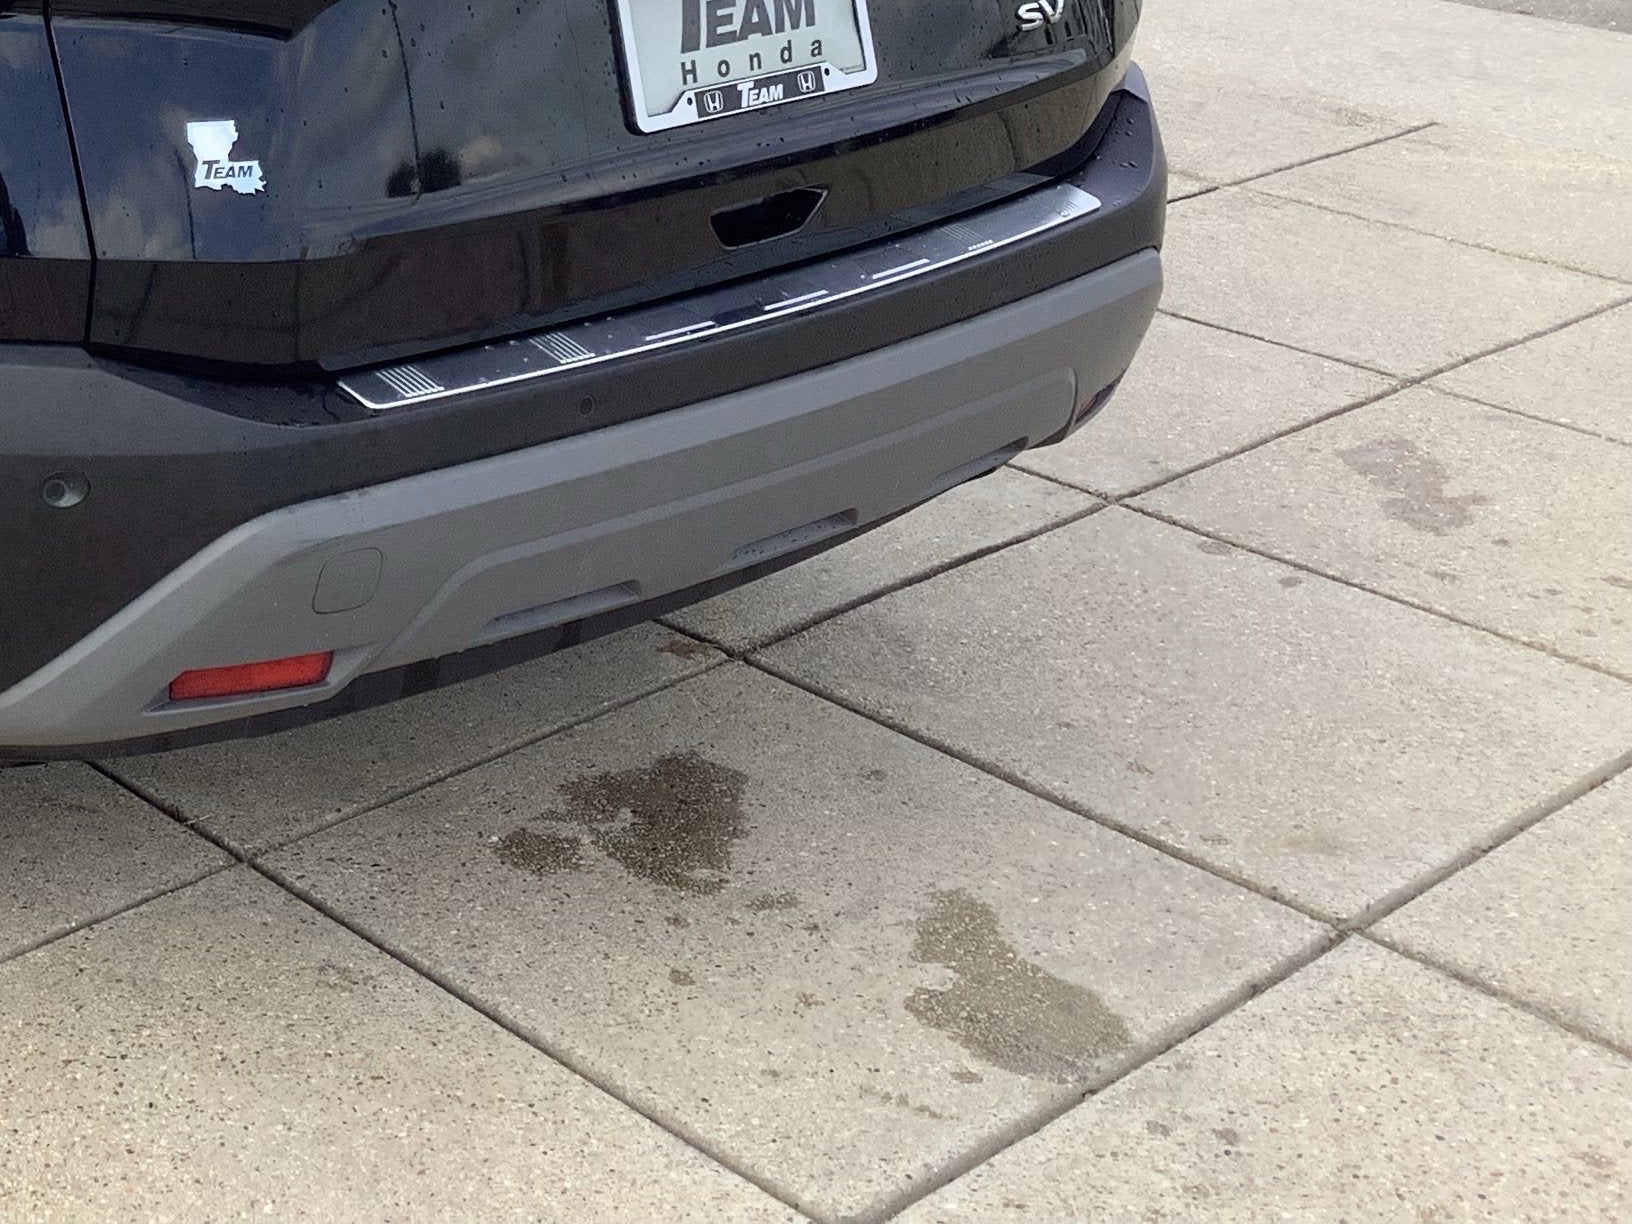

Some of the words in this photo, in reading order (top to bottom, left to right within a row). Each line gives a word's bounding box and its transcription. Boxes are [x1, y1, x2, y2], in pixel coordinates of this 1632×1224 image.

[680, 39, 824, 86] Honda
[737, 80, 784, 108] TEAM
[201, 159, 254, 180] TEAM
